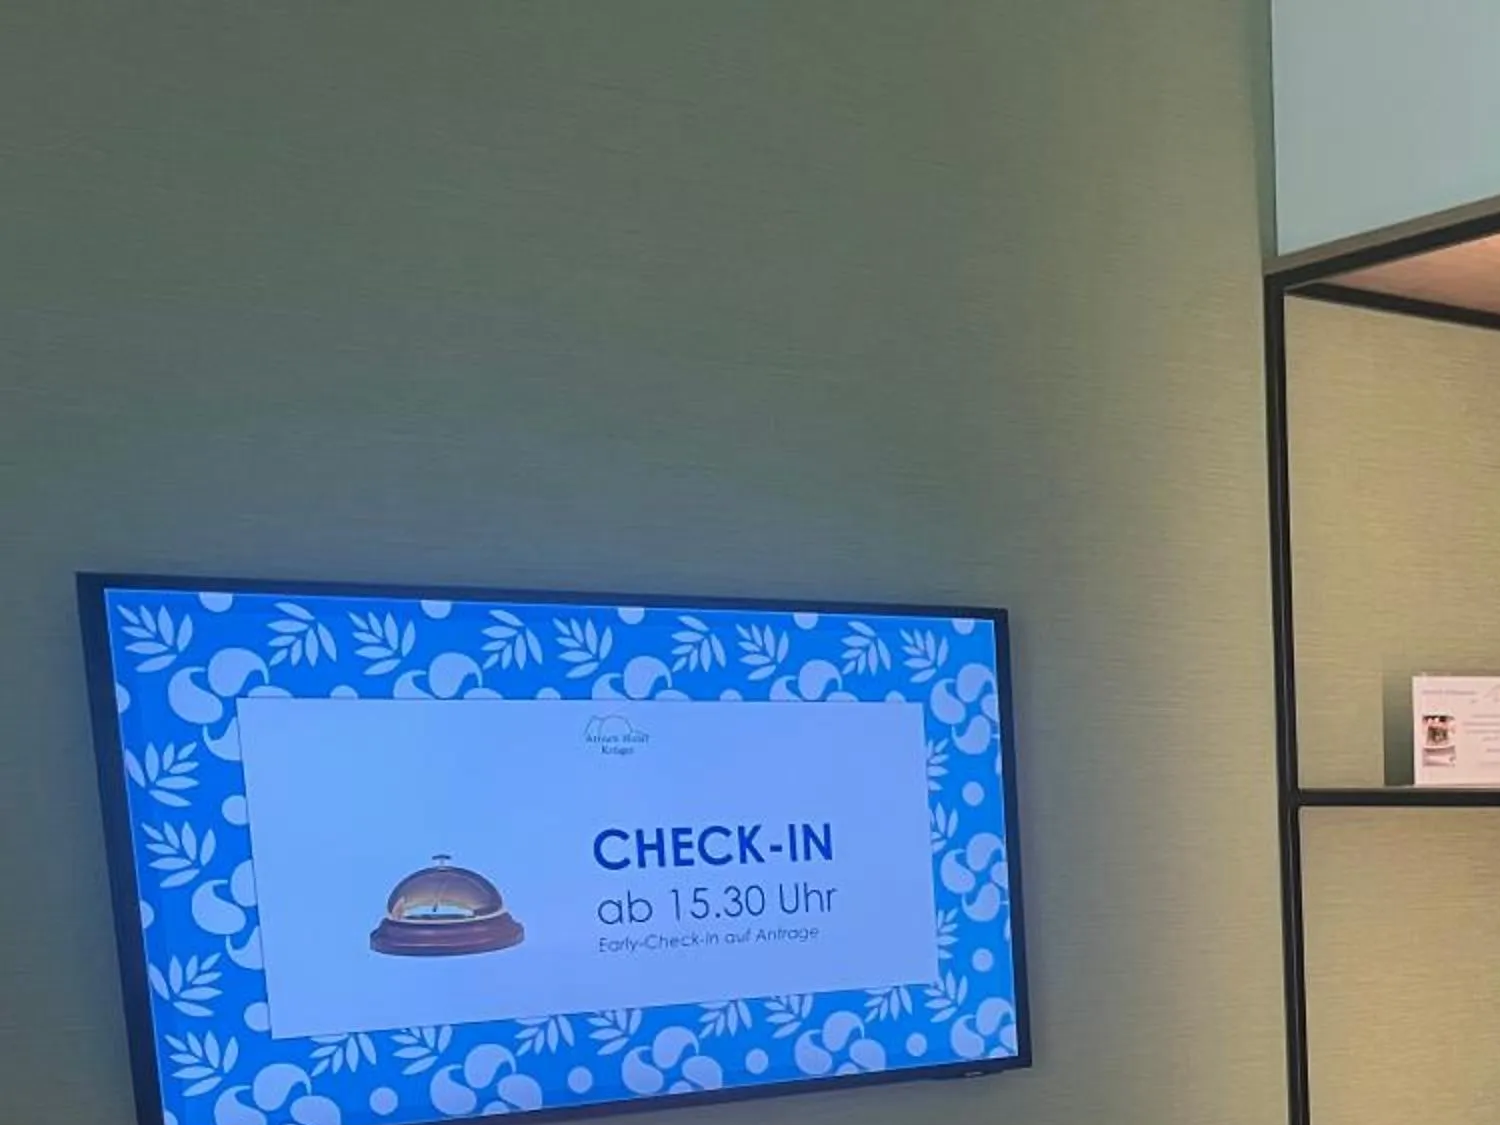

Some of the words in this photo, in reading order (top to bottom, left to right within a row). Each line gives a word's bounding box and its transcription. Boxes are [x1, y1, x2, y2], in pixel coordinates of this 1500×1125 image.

[593, 822, 833, 870] CHECK-IN
[598, 890, 653, 925] ab
[671, 885, 765, 921] 15.30
[778, 882, 838, 914] Uhr
[724, 927, 751, 944] auf
